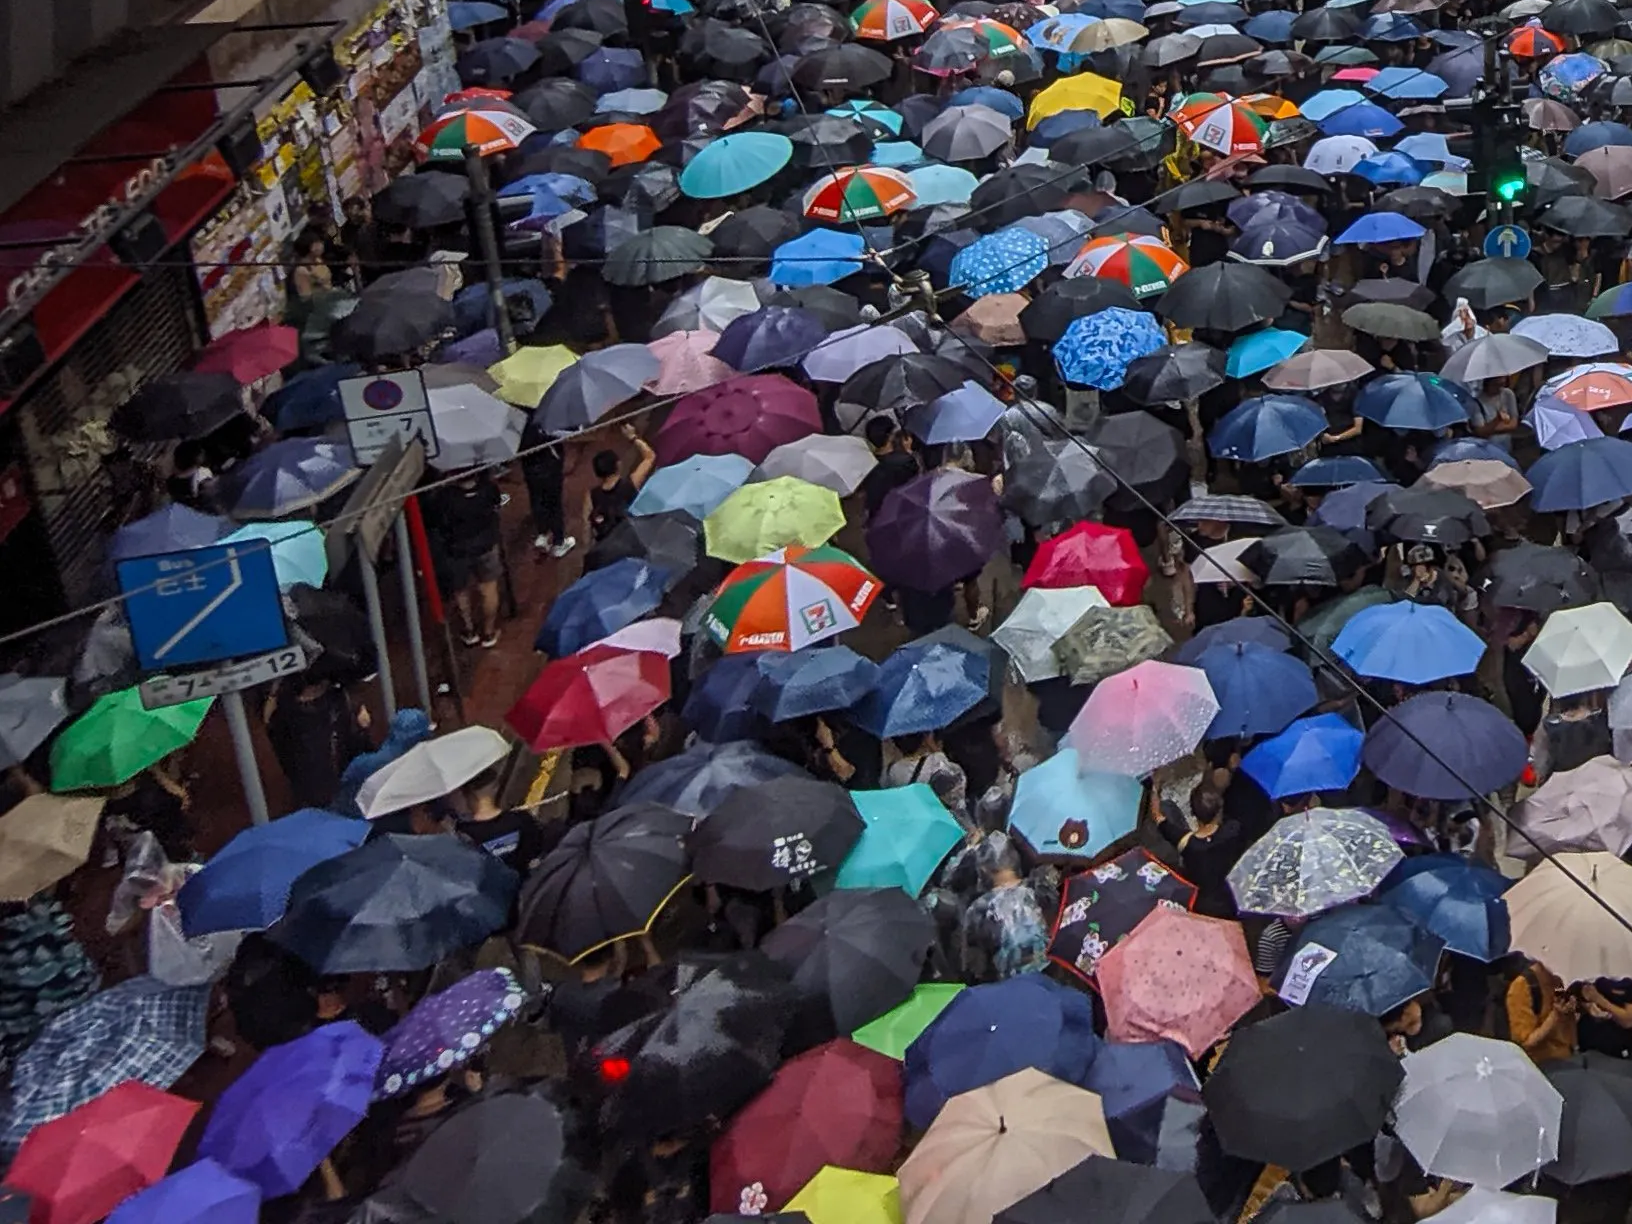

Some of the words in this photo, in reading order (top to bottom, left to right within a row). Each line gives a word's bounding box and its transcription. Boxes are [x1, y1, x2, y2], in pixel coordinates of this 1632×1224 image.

[399, 417, 412, 432] 7
[157, 559, 194, 572] Bus
[156, 573, 207, 596] 巴士
[266, 652, 298, 674] 12
